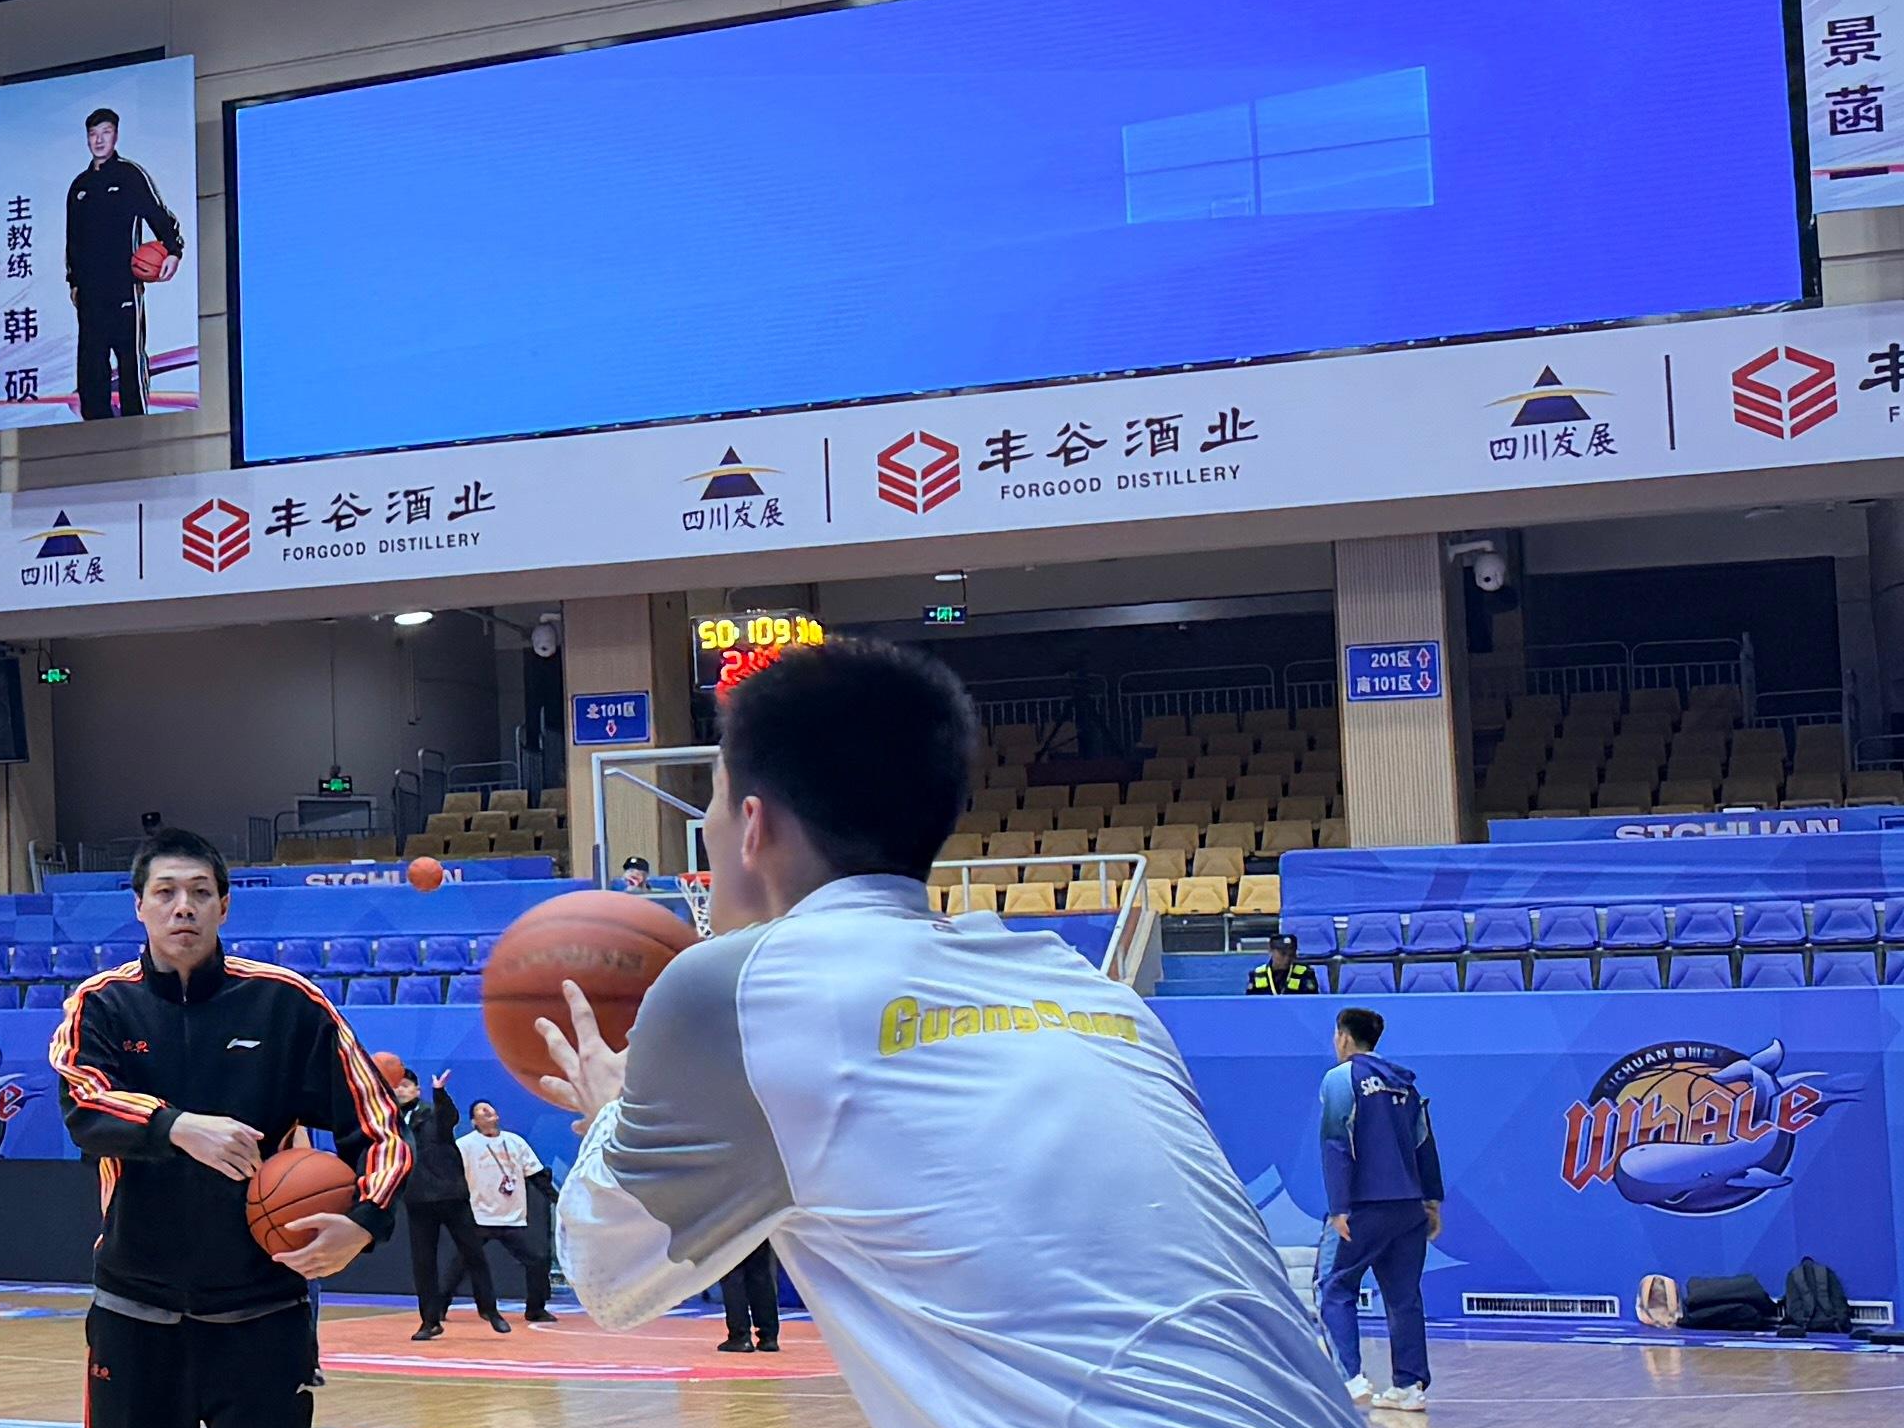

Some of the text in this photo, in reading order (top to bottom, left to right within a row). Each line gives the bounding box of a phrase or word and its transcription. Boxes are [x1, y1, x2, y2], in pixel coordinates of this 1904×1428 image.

[6, 196, 33, 279] 主教练
[978, 407, 1259, 474] 丰谷酒业
[1489, 422, 1619, 462] 四川发展
[1000, 464, 1241, 501] FORGOOD DISTILLERY
[264, 480, 496, 538] 丰谷酒业
[682, 496, 785, 532] 四川发展
[282, 530, 481, 562] FORGOOD DISTILLERY
[21, 556, 106, 586] 四川发展
